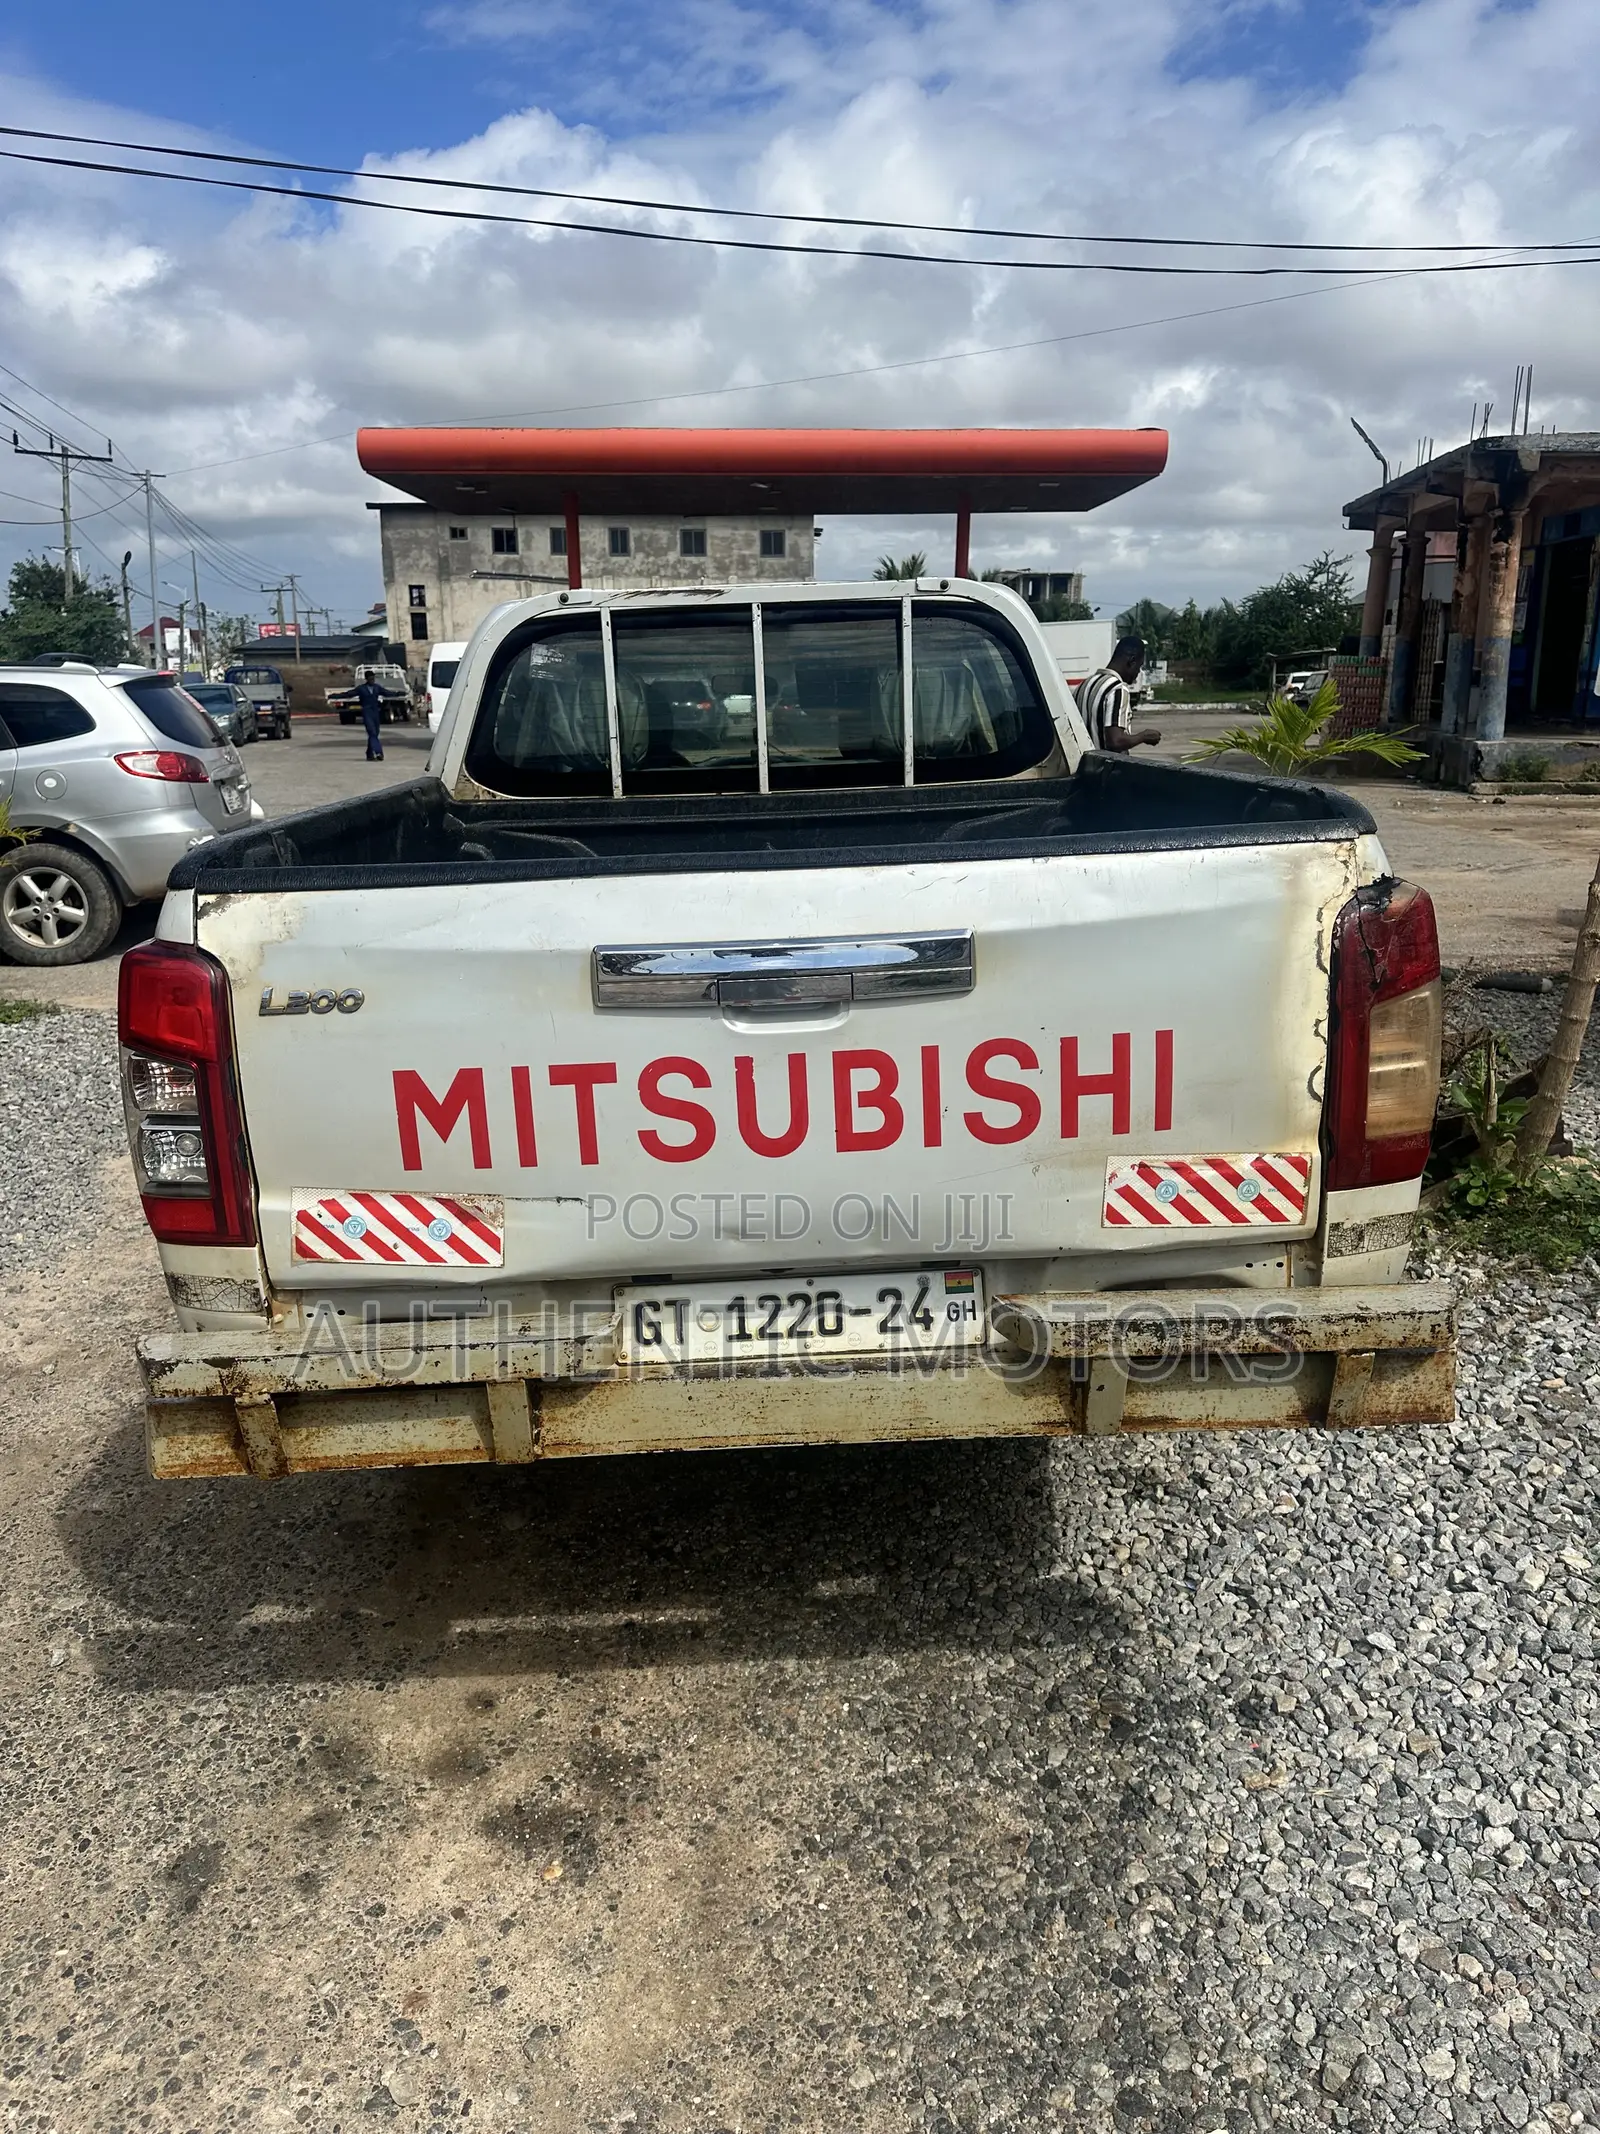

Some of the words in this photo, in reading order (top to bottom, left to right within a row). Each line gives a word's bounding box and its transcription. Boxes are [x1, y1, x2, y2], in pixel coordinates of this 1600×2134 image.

[259, 987, 365, 1016] L200
[392, 1029, 1174, 1171] MITSUBISHI
[635, 1299, 691, 1345] GT
[726, 1286, 934, 1341] 1220-24
[947, 1299, 977, 1322] GH
